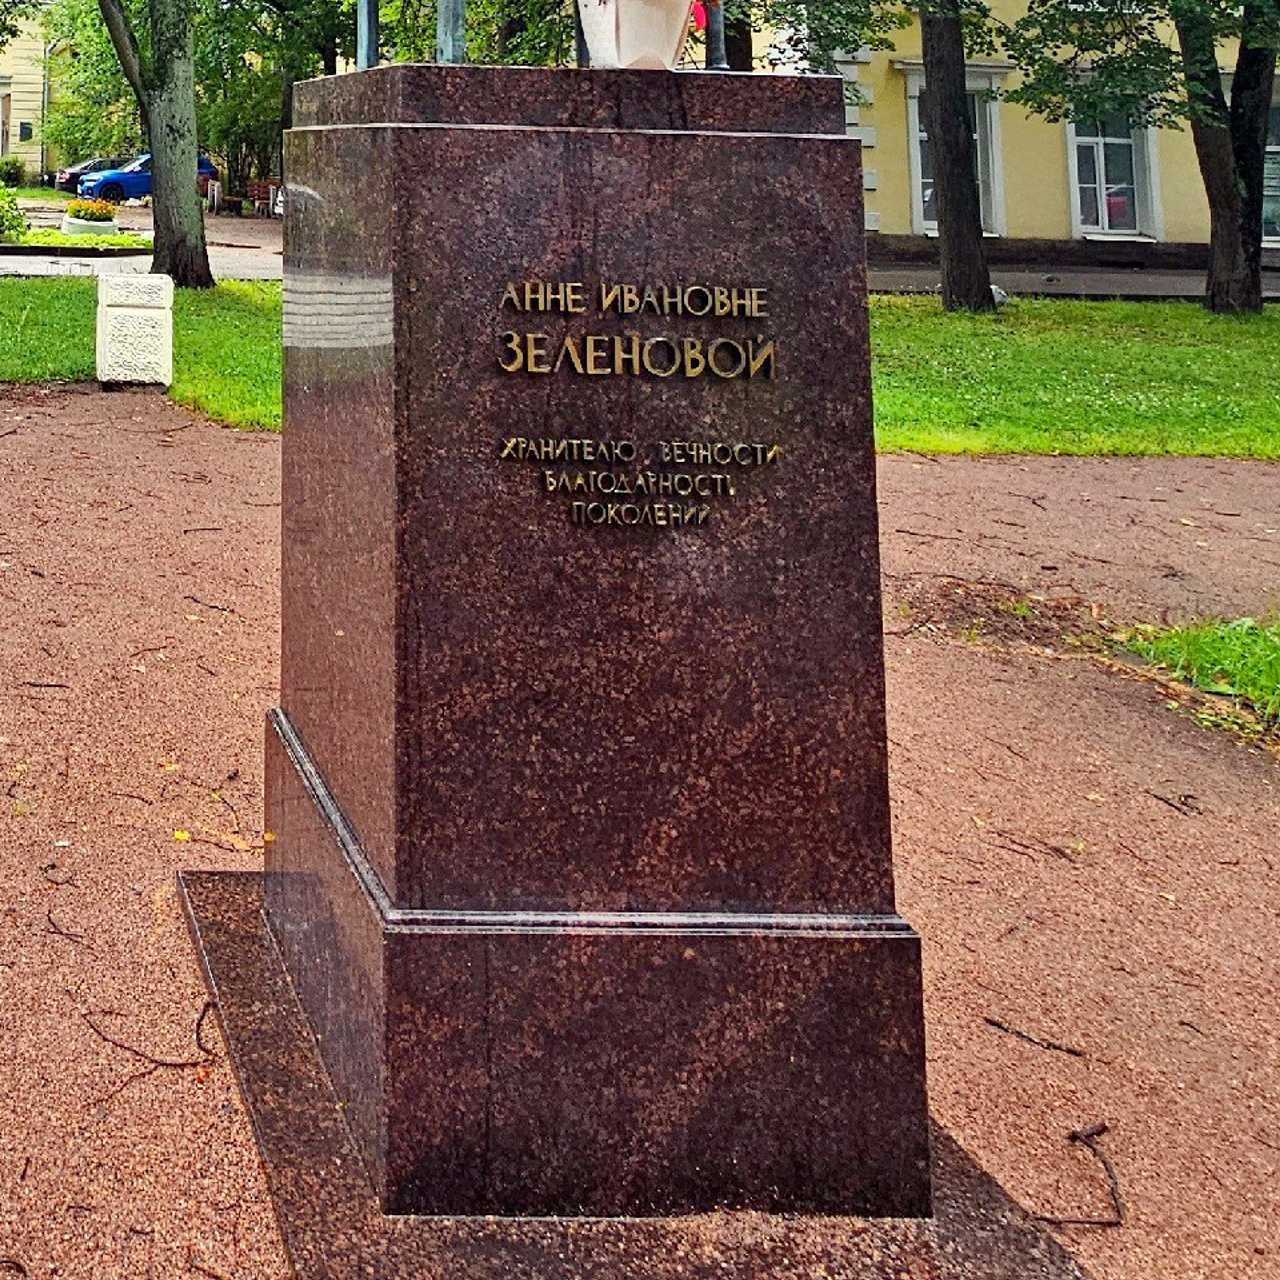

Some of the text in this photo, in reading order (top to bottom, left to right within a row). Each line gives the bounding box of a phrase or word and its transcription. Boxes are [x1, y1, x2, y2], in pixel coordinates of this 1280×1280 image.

[499, 282, 770, 317] АННЕ ИВАНОВНЕ
[498, 331, 777, 379] ЗЕЛЕНОВОЙ
[499, 438, 780, 465] ХРАНИТЕЛЮ ВЕЧНОСТИ
[544, 470, 736, 496] БЛАГОДАРНОСТЬ
